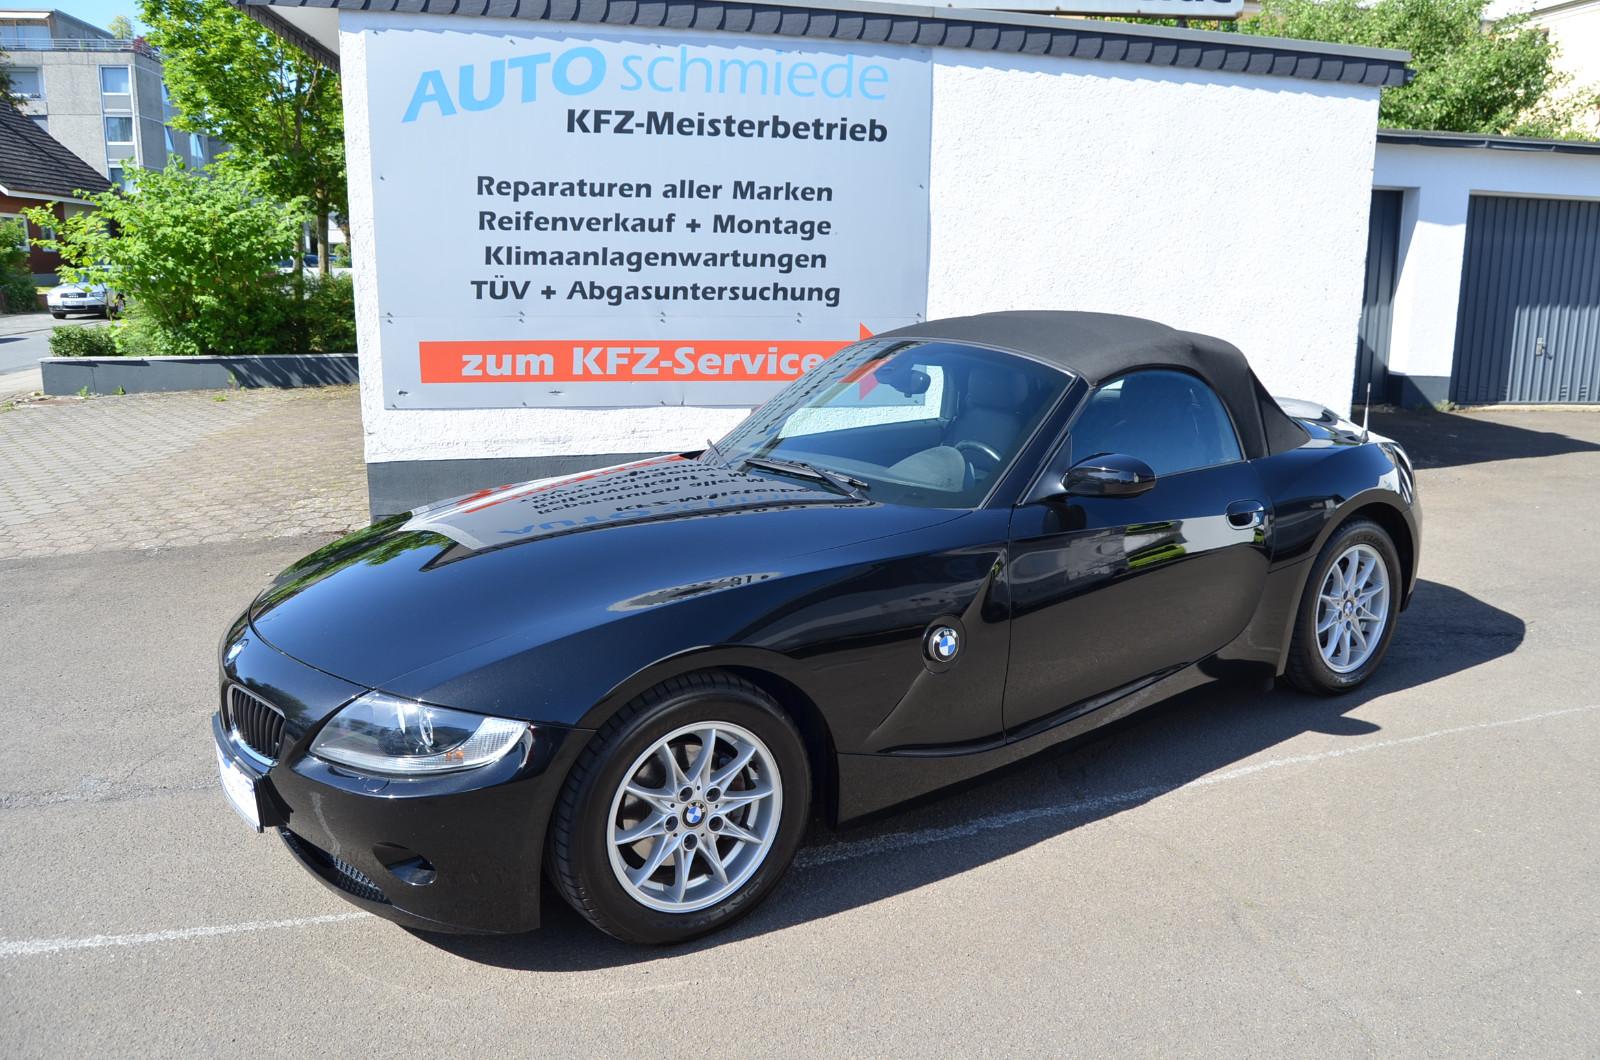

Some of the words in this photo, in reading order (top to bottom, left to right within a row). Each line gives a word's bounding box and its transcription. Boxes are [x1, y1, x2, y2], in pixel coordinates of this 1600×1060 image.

[402, 46, 607, 124] AUTO
[619, 45, 889, 102] schmiede
[567, 109, 888, 143] KFZ-Meisterbetrieb
[477, 175, 652, 202] Reparaturen
[662, 179, 723, 200] aller
[732, 180, 833, 203] Marken
[478, 210, 676, 233] Reifenverkauf
[686, 218, 701, 233] +
[712, 214, 832, 241] Montage
[484, 245, 827, 274] Klimaanlagenwartungen
[471, 274, 531, 300] TÜV
[541, 285, 557, 300] +
[566, 280, 841, 308] Abgasuntersuchung
[461, 353, 555, 377] zum
[572, 346, 825, 376] KFZ-Service
